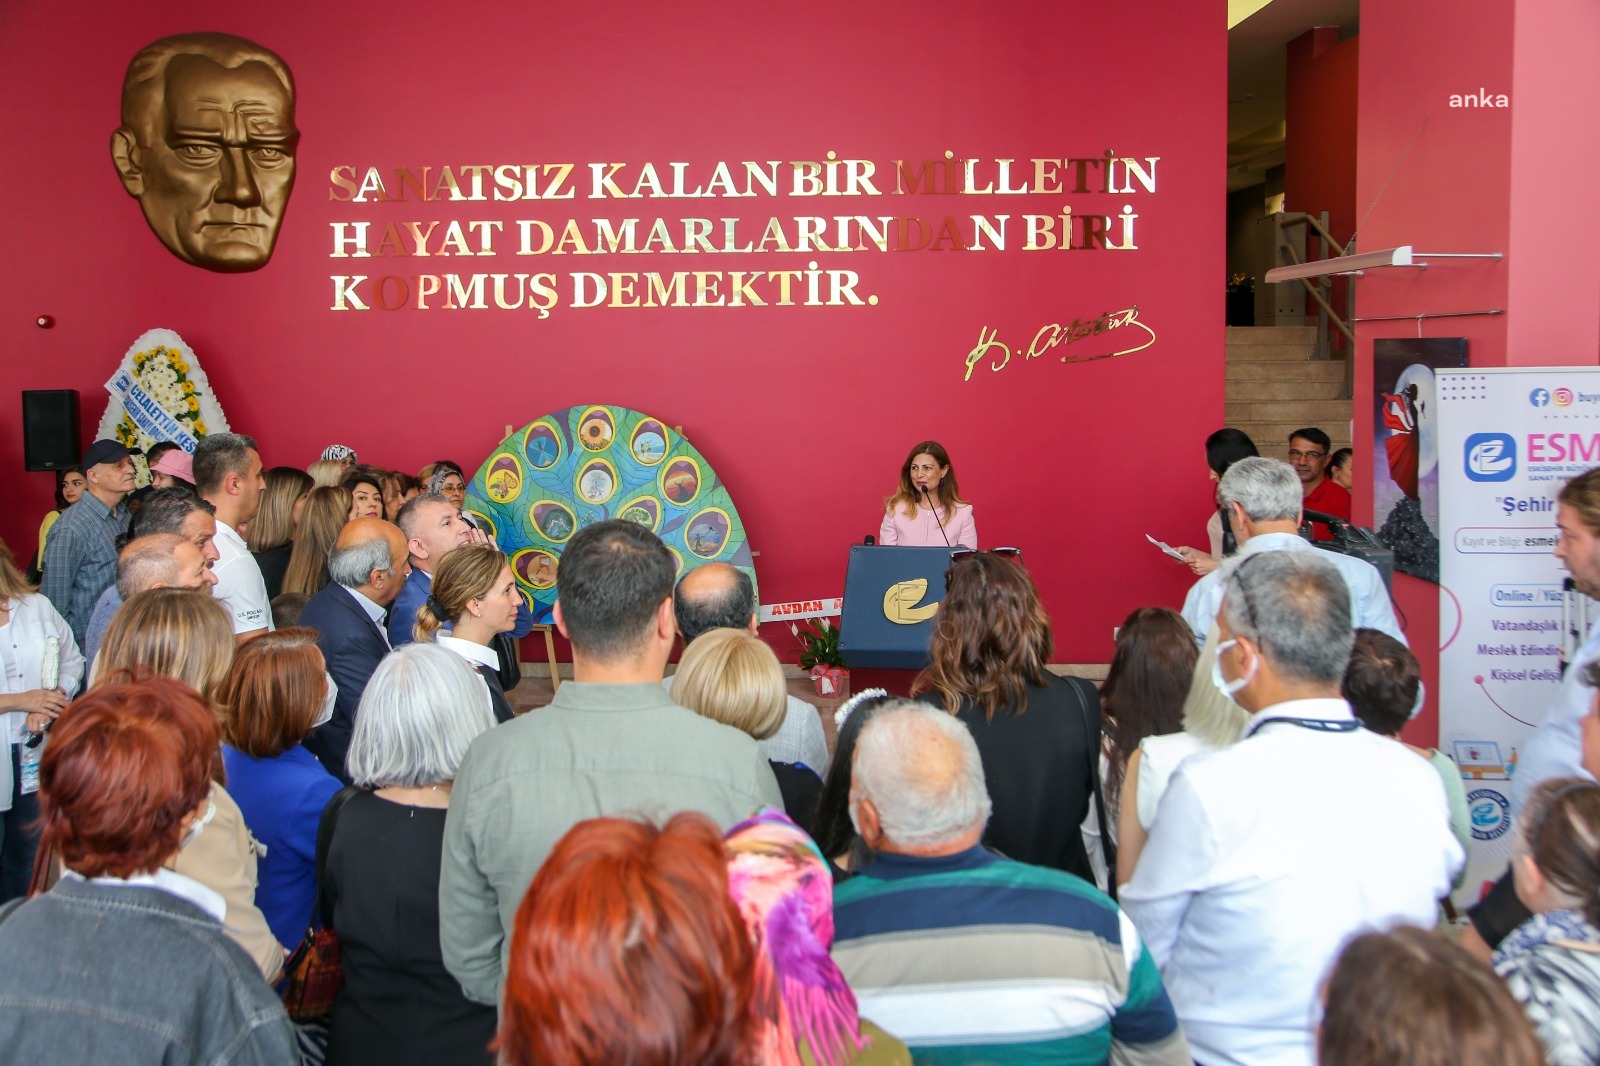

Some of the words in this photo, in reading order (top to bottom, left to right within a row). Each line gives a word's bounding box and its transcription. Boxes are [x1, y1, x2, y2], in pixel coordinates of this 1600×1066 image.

[329, 163, 576, 202] SANATSIZ
[588, 160, 782, 198] KALAN
[789, 151, 882, 196] BİR
[891, 149, 1161, 195] MİLLETİN
[330, 219, 503, 258] HAYAT
[516, 214, 1010, 256] DAMARLARINDAN
[1022, 205, 1139, 251] BİRİ
[330, 274, 558, 319] KOPMUŞ
[570, 261, 879, 309] DEMEKTİR.
[130, 384, 180, 436] CELALETTİN
[1487, 538, 1497, 546] ve
[1496, 589, 1533, 601] Online
[1536, 588, 1542, 602] /
[772, 601, 823, 615] AVDAN
[1492, 619, 1558, 633] Vatandaşlık
[1477, 644, 1517, 656] Meslek
[1490, 669, 1527, 683] Kişisel
